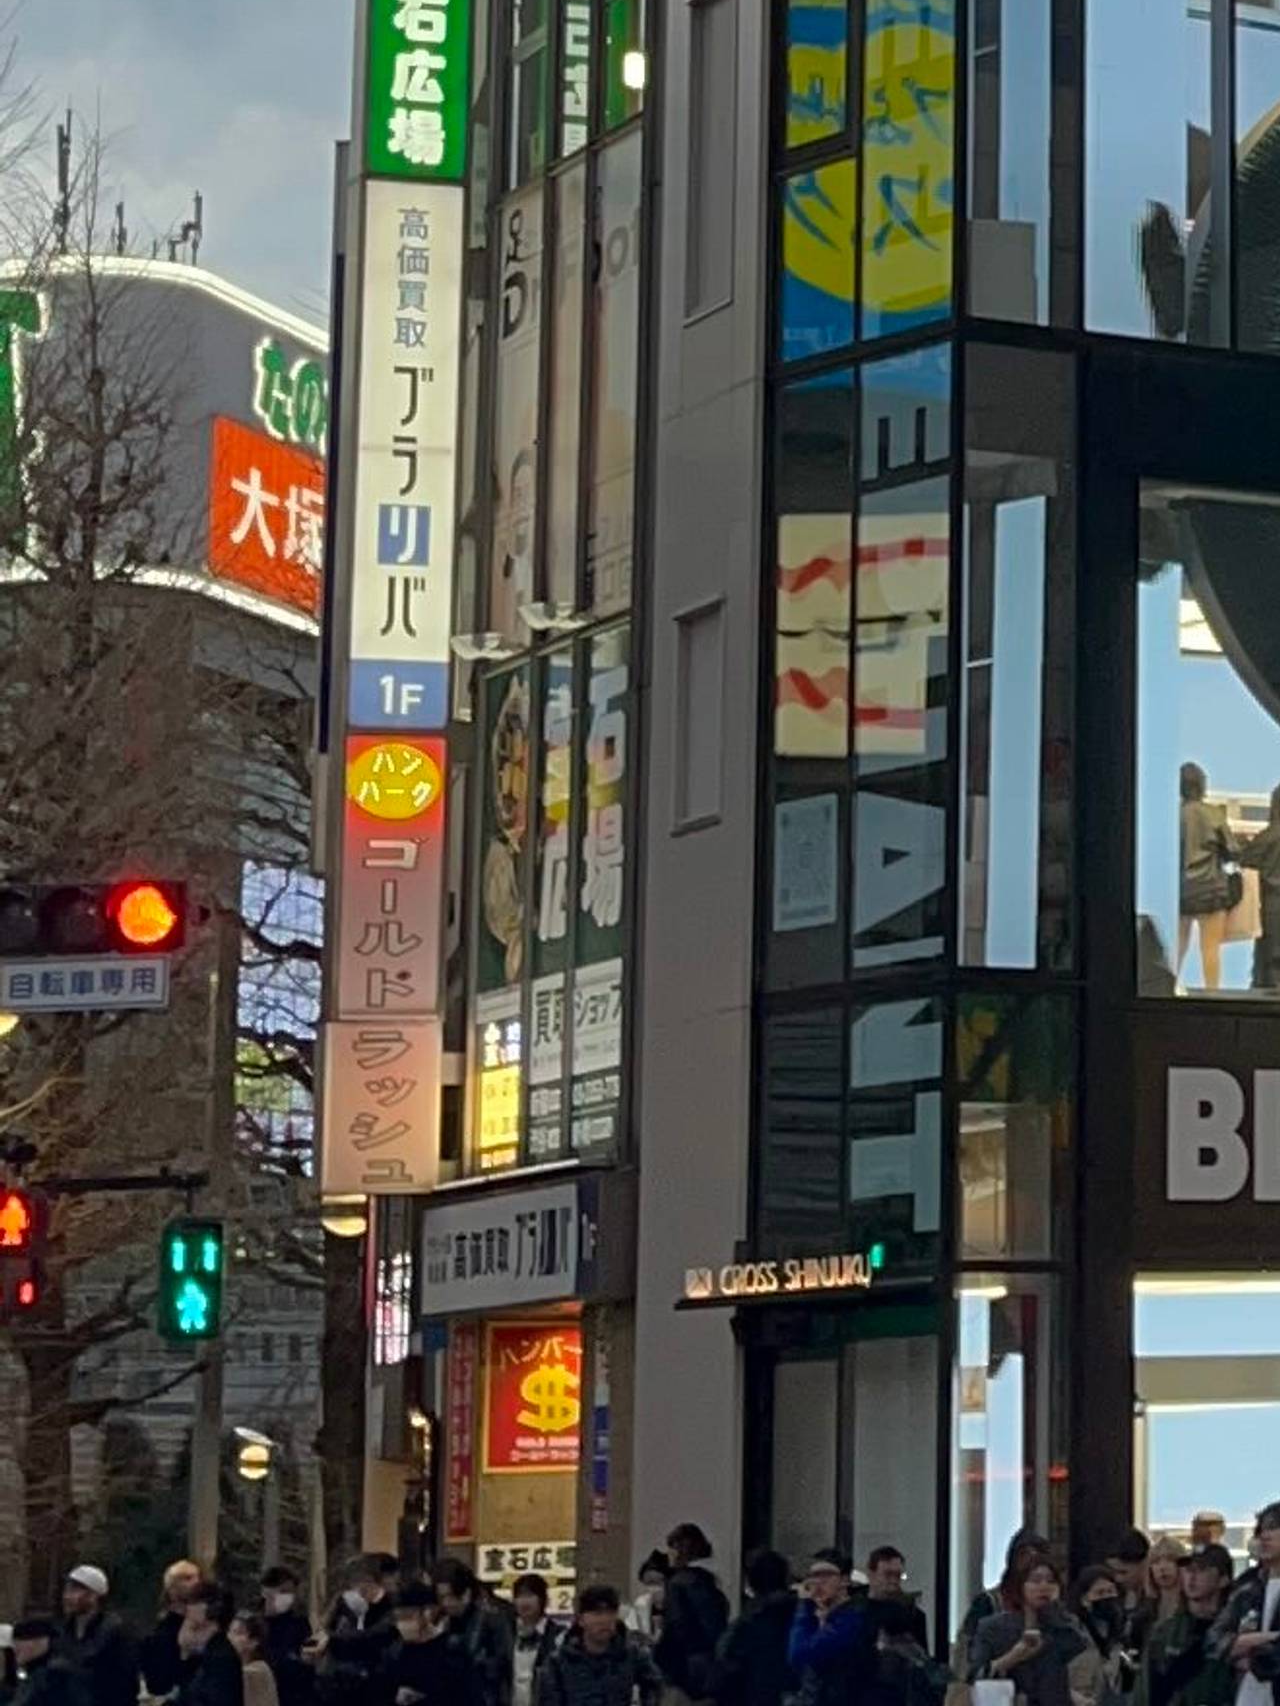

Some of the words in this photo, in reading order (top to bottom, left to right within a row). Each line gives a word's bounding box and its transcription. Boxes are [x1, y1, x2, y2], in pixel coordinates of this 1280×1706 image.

[393, 207, 431, 349] 高価買取
[380, 366, 434, 639] ブラリバ
[379, 675, 424, 715] 1F
[8, 966, 158, 1001] 自転車専用
[719, 1260, 780, 1296] CROSS
[783, 1252, 873, 1290] SHINJUKU
